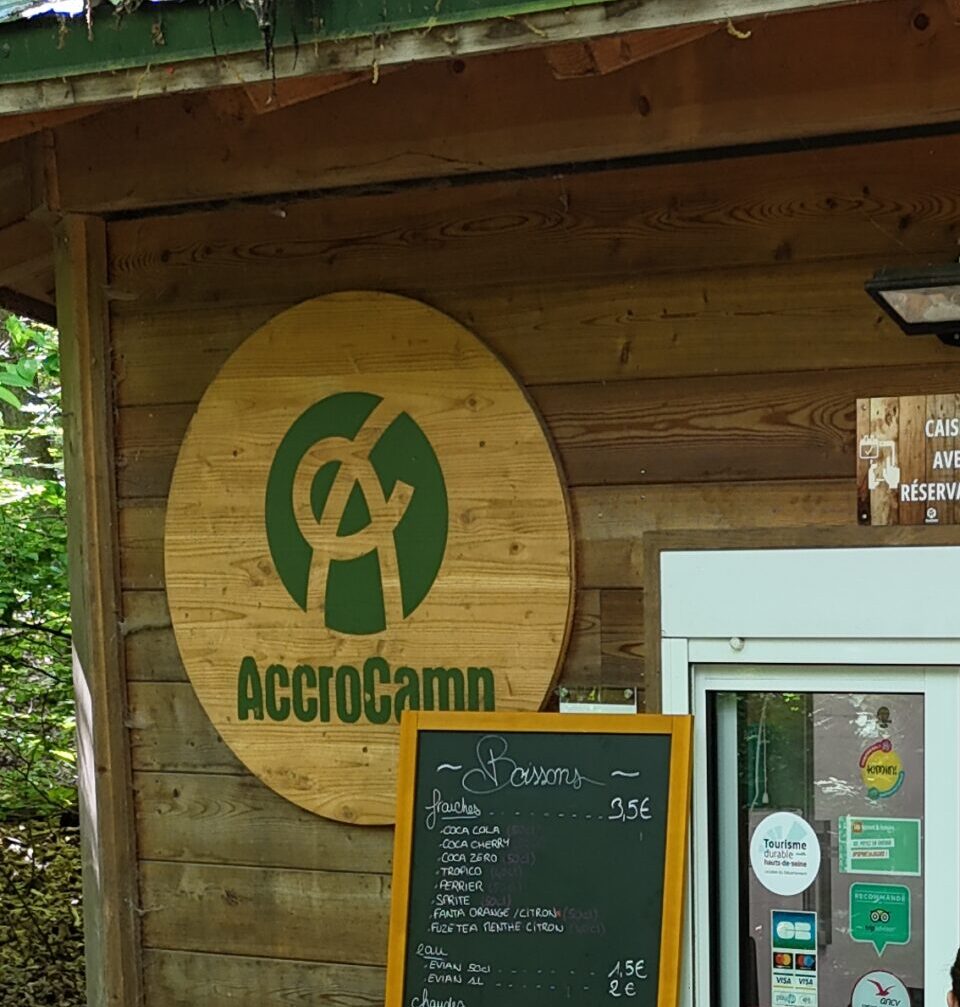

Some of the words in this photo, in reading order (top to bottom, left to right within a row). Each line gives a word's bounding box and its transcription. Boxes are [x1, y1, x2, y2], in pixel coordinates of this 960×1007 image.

[608, 797, 652, 823] 3,5€
[443, 825, 470, 836] COCA
[473, 825, 500, 836] COLA
[442, 840, 468, 850] COCA
[470, 838, 510, 849] CHERRY
[764, 839, 807, 850] Tourisme
[441, 852, 467, 864] COCA
[469, 852, 498, 863] ZERO
[764, 850, 794, 860] durable
[440, 867, 482, 877] TROPICO
[439, 880, 483, 892] PERRIER
[435, 895, 470, 907] SPRITE
[433, 908, 466, 919] FANTA
[469, 908, 510, 918] ORANGE
[429, 961, 462, 972] EVIAN
[608, 959, 648, 979] 1,5€
[427, 973, 462, 985] EVIAN
[776, 976, 791, 985] VISA
[798, 977, 814, 986] VISA
